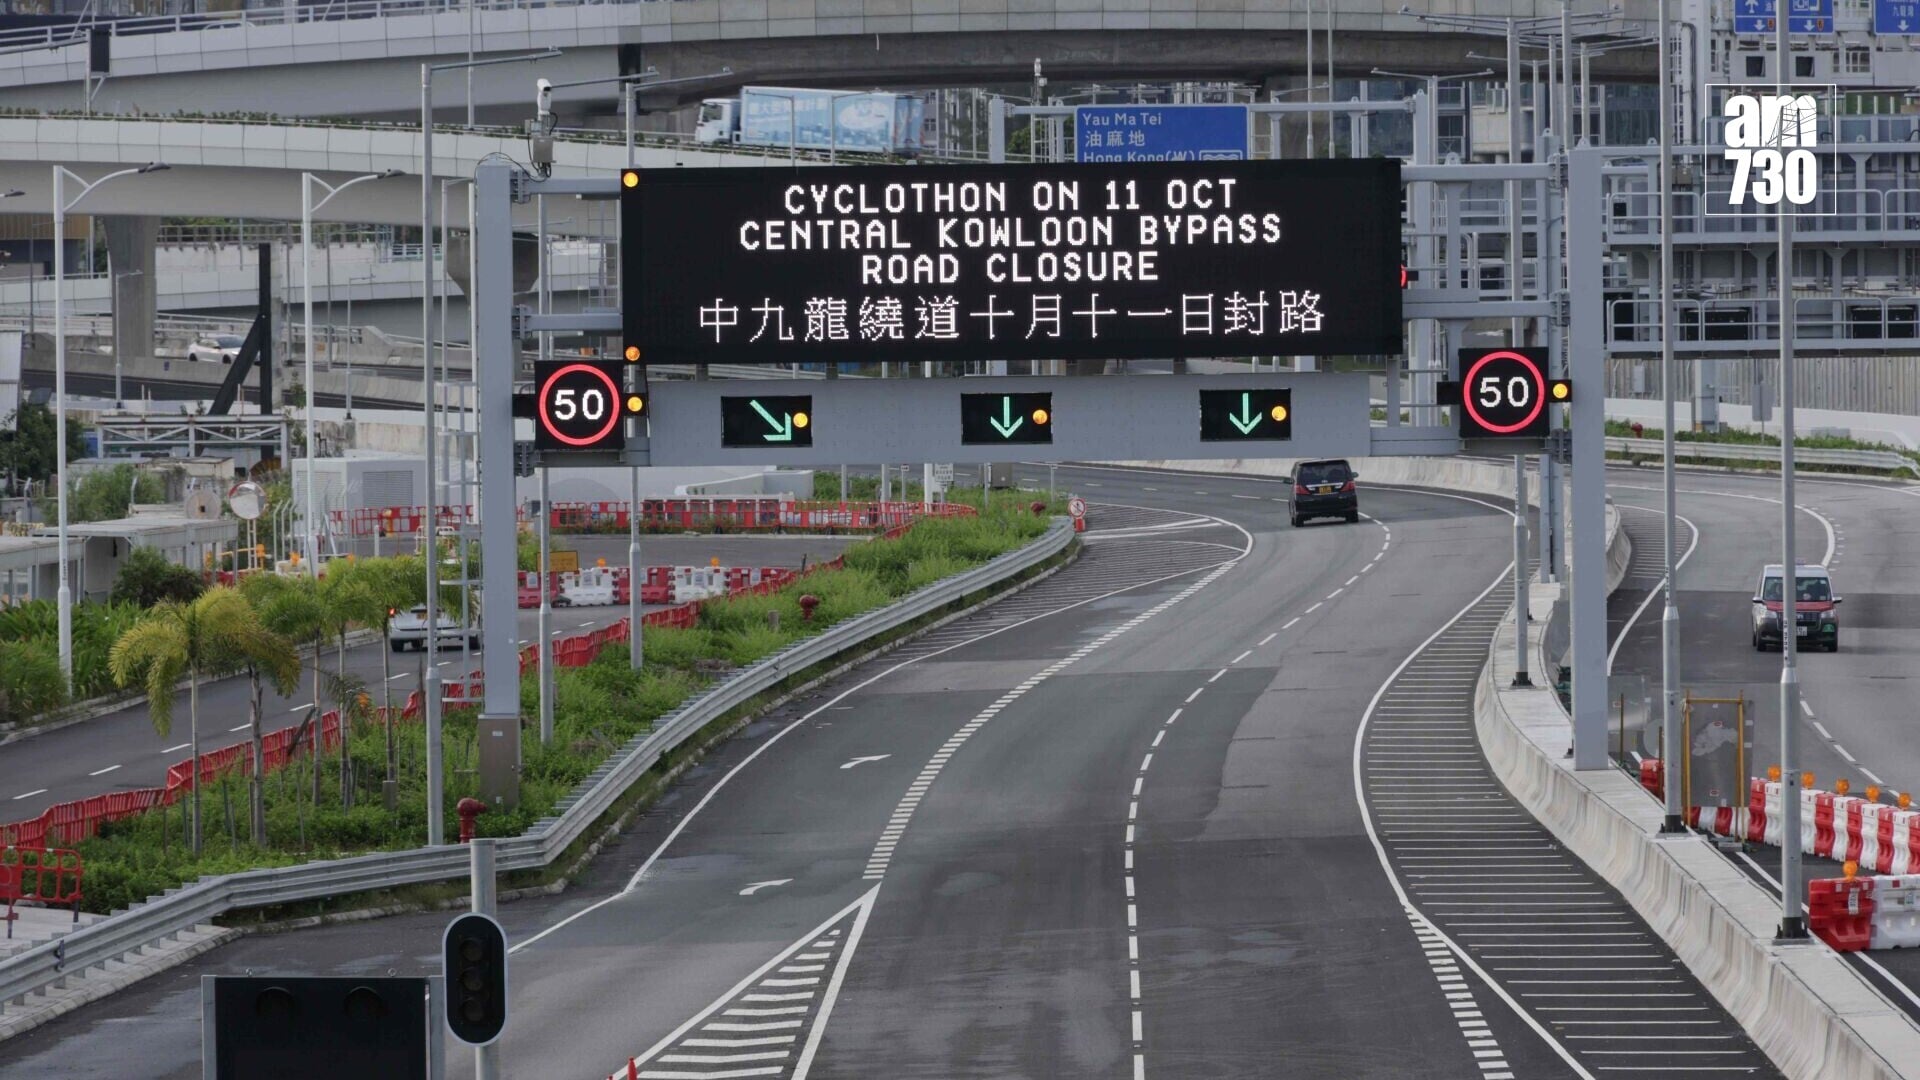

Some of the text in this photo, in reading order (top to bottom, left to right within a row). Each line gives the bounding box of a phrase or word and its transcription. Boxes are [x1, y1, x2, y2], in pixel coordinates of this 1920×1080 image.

[1082, 112, 1162, 126] Yau Ma Tei
[1085, 130, 1145, 147] 油麻地
[1083, 152, 1122, 162] Hong
[784, 178, 1237, 213] CYCLOTHON ON 11 OCT
[739, 214, 1281, 251] CENTRAL KOWLOON BYPASS
[862, 250, 1159, 285] ROAD CLOSURE
[699, 288, 1326, 343] 中九龍繞道十月十一日封路
[554, 389, 604, 420] 50
[1479, 376, 1529, 408] 50
